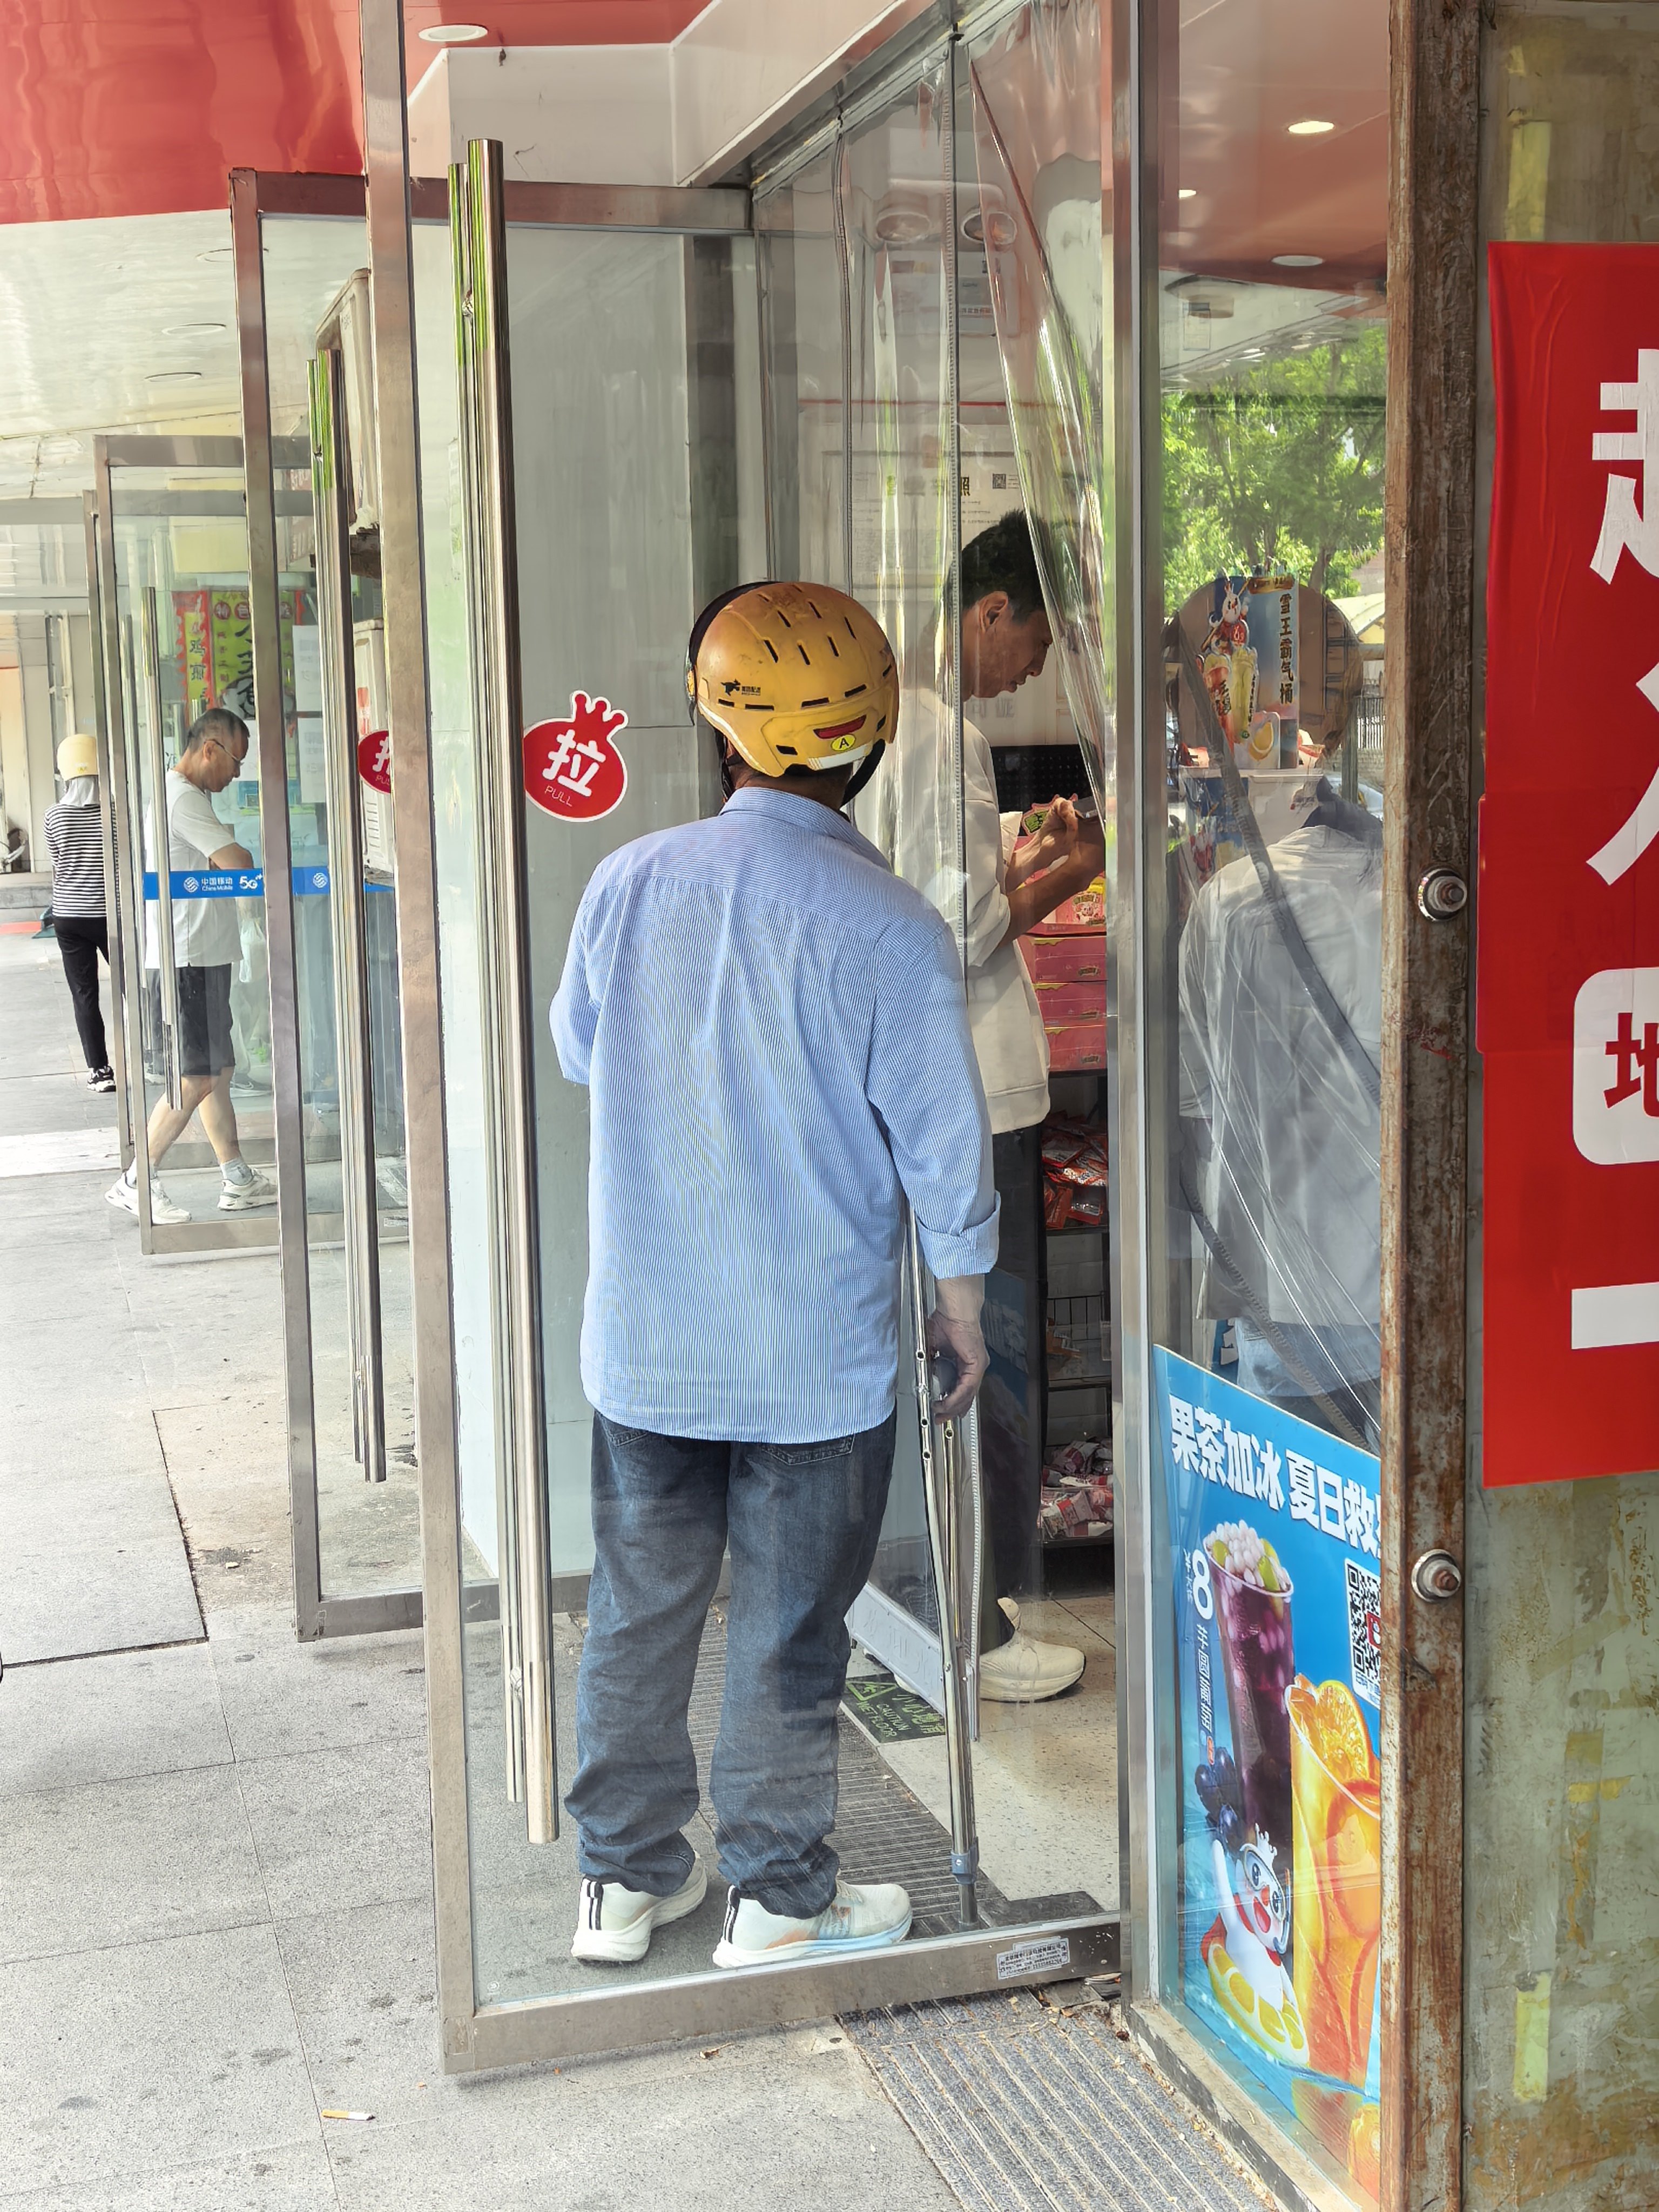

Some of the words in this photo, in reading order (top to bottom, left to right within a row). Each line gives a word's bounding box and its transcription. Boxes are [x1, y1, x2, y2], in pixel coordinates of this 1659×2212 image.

[839, 737, 849, 749] A
[542, 729, 606, 797] 拉
[544, 785, 572, 807] PULL
[201, 876, 233, 886] 中国移动
[1169, 1393, 1285, 1510] 果茶加冰
[1286, 1448, 1381, 1559] 夏日救
[1192, 1549, 1213, 1620] 8
[1196, 1623, 1213, 1733] 芋圆葡萄
[857, 1701, 878, 1716] WET
[871, 1715, 897, 1737] FLOOR
[876, 1703, 912, 1731] CAUTION
